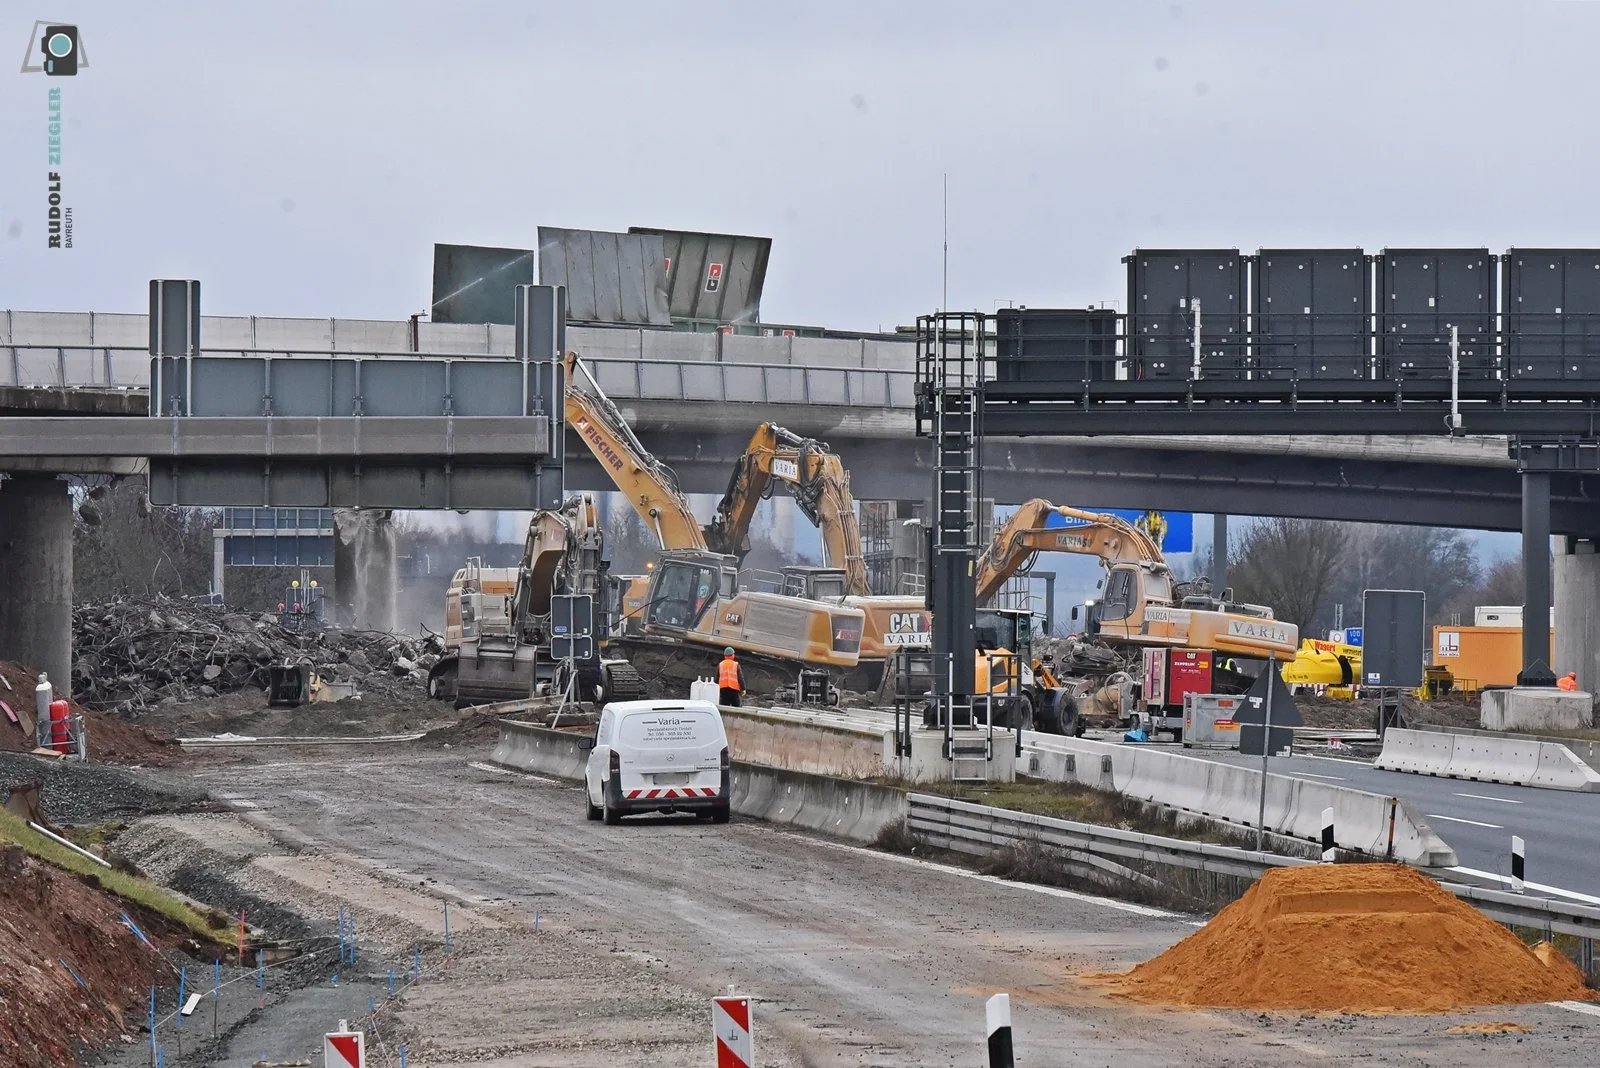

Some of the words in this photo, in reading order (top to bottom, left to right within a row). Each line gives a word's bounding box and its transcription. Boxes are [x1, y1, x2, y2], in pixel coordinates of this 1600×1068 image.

[585, 425, 624, 471] FISCHER
[775, 461, 797, 476] VARIA
[726, 613, 739, 622] CAT
[890, 613, 920, 633] CAT
[1146, 610, 1168, 621] VARIA
[1233, 621, 1286, 641] VARIA
[657, 717, 680, 725] Varia
